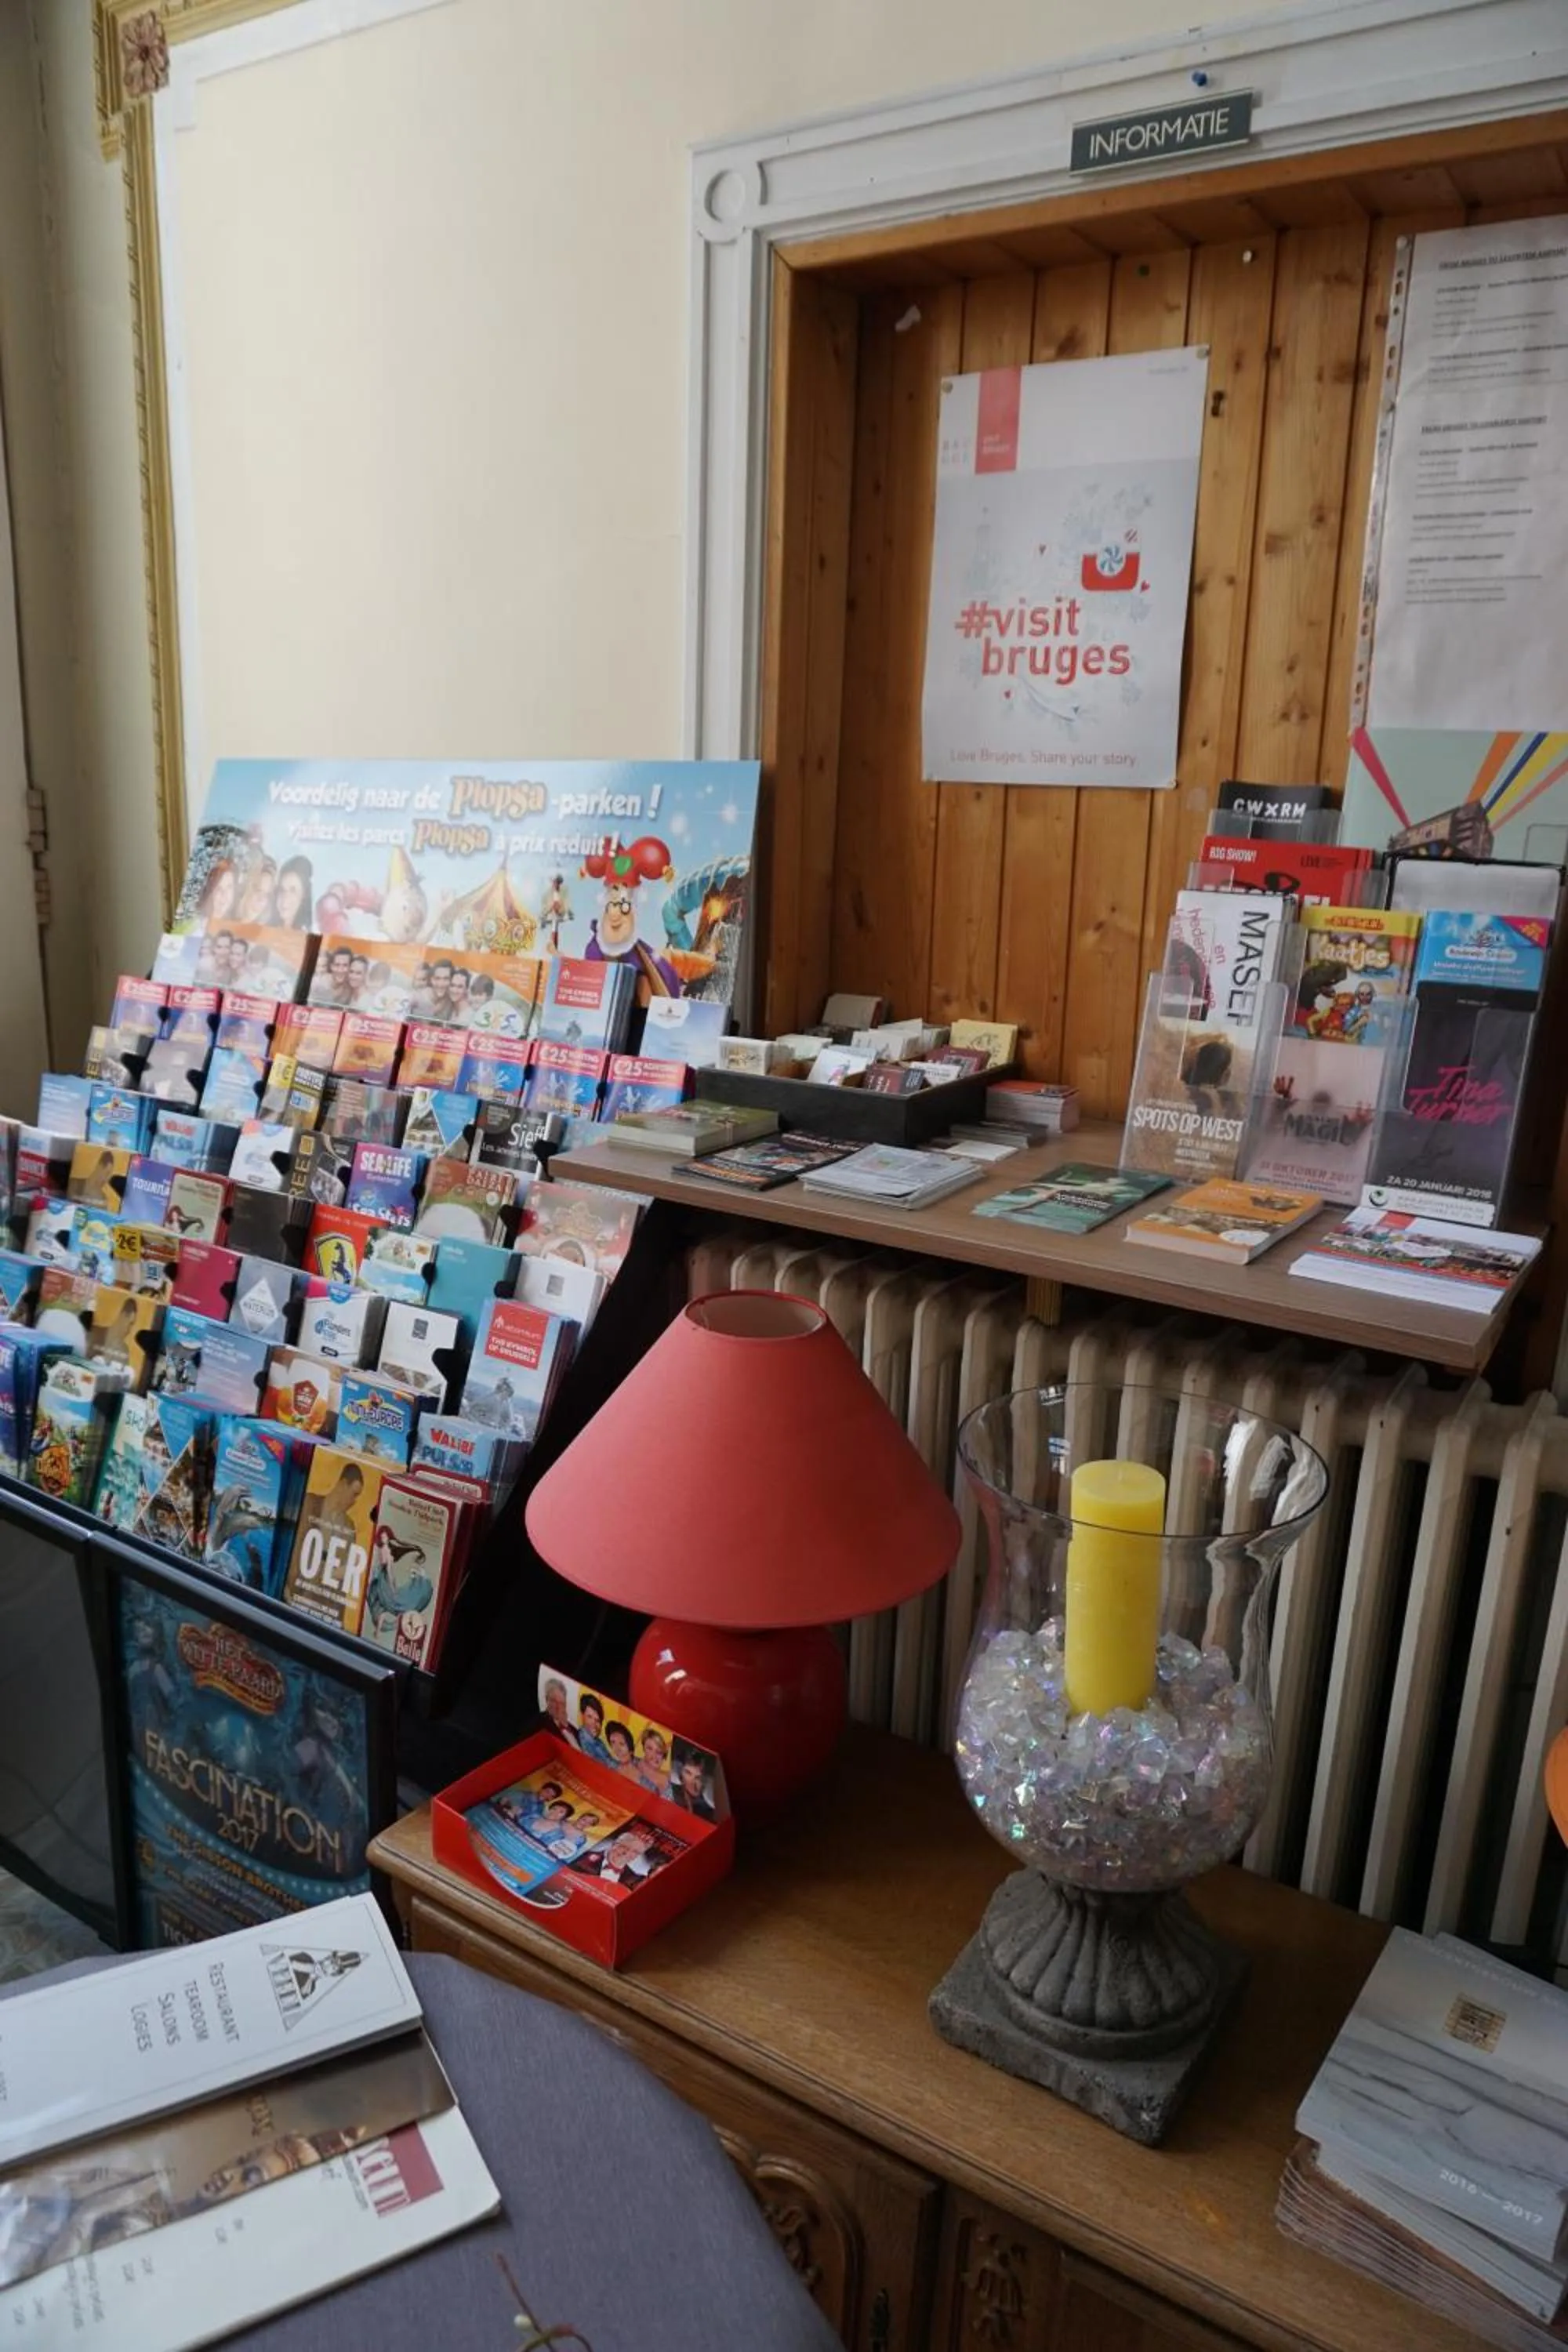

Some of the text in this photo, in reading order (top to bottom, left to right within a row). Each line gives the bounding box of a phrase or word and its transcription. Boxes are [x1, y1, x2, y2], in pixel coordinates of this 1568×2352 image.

[1089, 107, 1230, 160] INFORMATIE
[954, 597, 1081, 639] #visit
[982, 637, 1131, 685] bruges
[1029, 748, 1067, 764] Share
[269, 781, 360, 812] Voordelig
[363, 786, 410, 810] naar
[414, 784, 441, 810] de
[1209, 846, 1225, 860] BIG
[539, 1044, 568, 1065] €25
[613, 1058, 643, 1077] €25
[1133, 1105, 1244, 1142] SPOTS OP WEST
[360, 1151, 384, 1173] SEA
[1417, 1180, 1465, 1195] JANUARI
[299, 1527, 368, 1599] OER
[145, 1730, 342, 1874] FASCINATION
[217, 1812, 260, 1853] 2017
[158, 1992, 182, 2046] SALONS
[183, 1980, 210, 2043] TEAROOM
[209, 1961, 240, 2044] RESTAURANT
[1501, 2199, 1544, 2228] 2017
